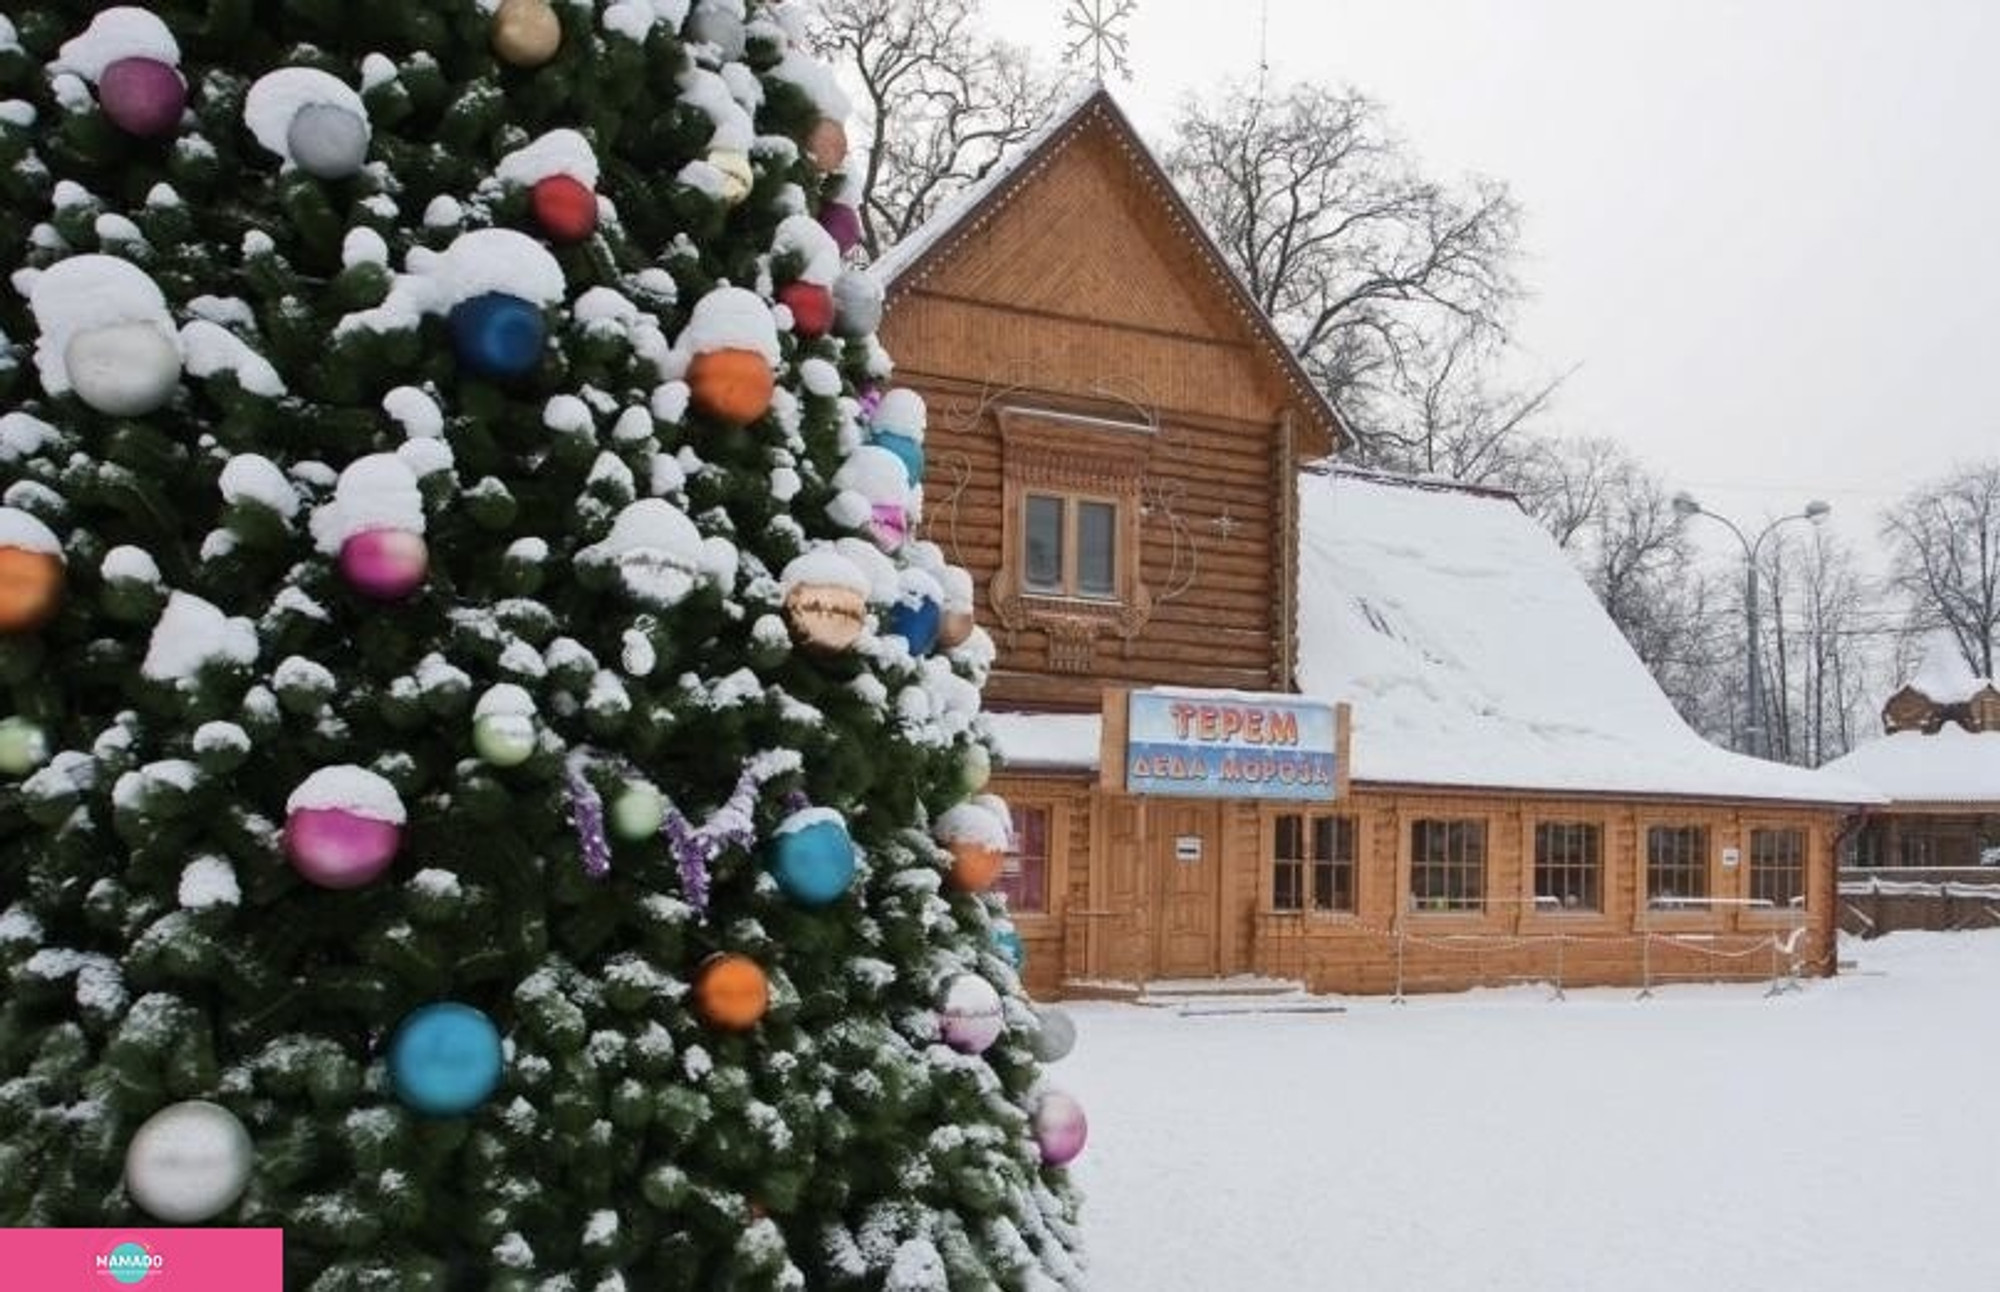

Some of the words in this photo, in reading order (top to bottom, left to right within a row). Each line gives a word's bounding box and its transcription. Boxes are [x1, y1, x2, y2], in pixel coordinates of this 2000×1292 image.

[1170, 702, 1298, 746] ТЕРЕМ
[1133, 753, 1208, 779] ДЕДА
[1220, 756, 1329, 787] МОРОЗА
